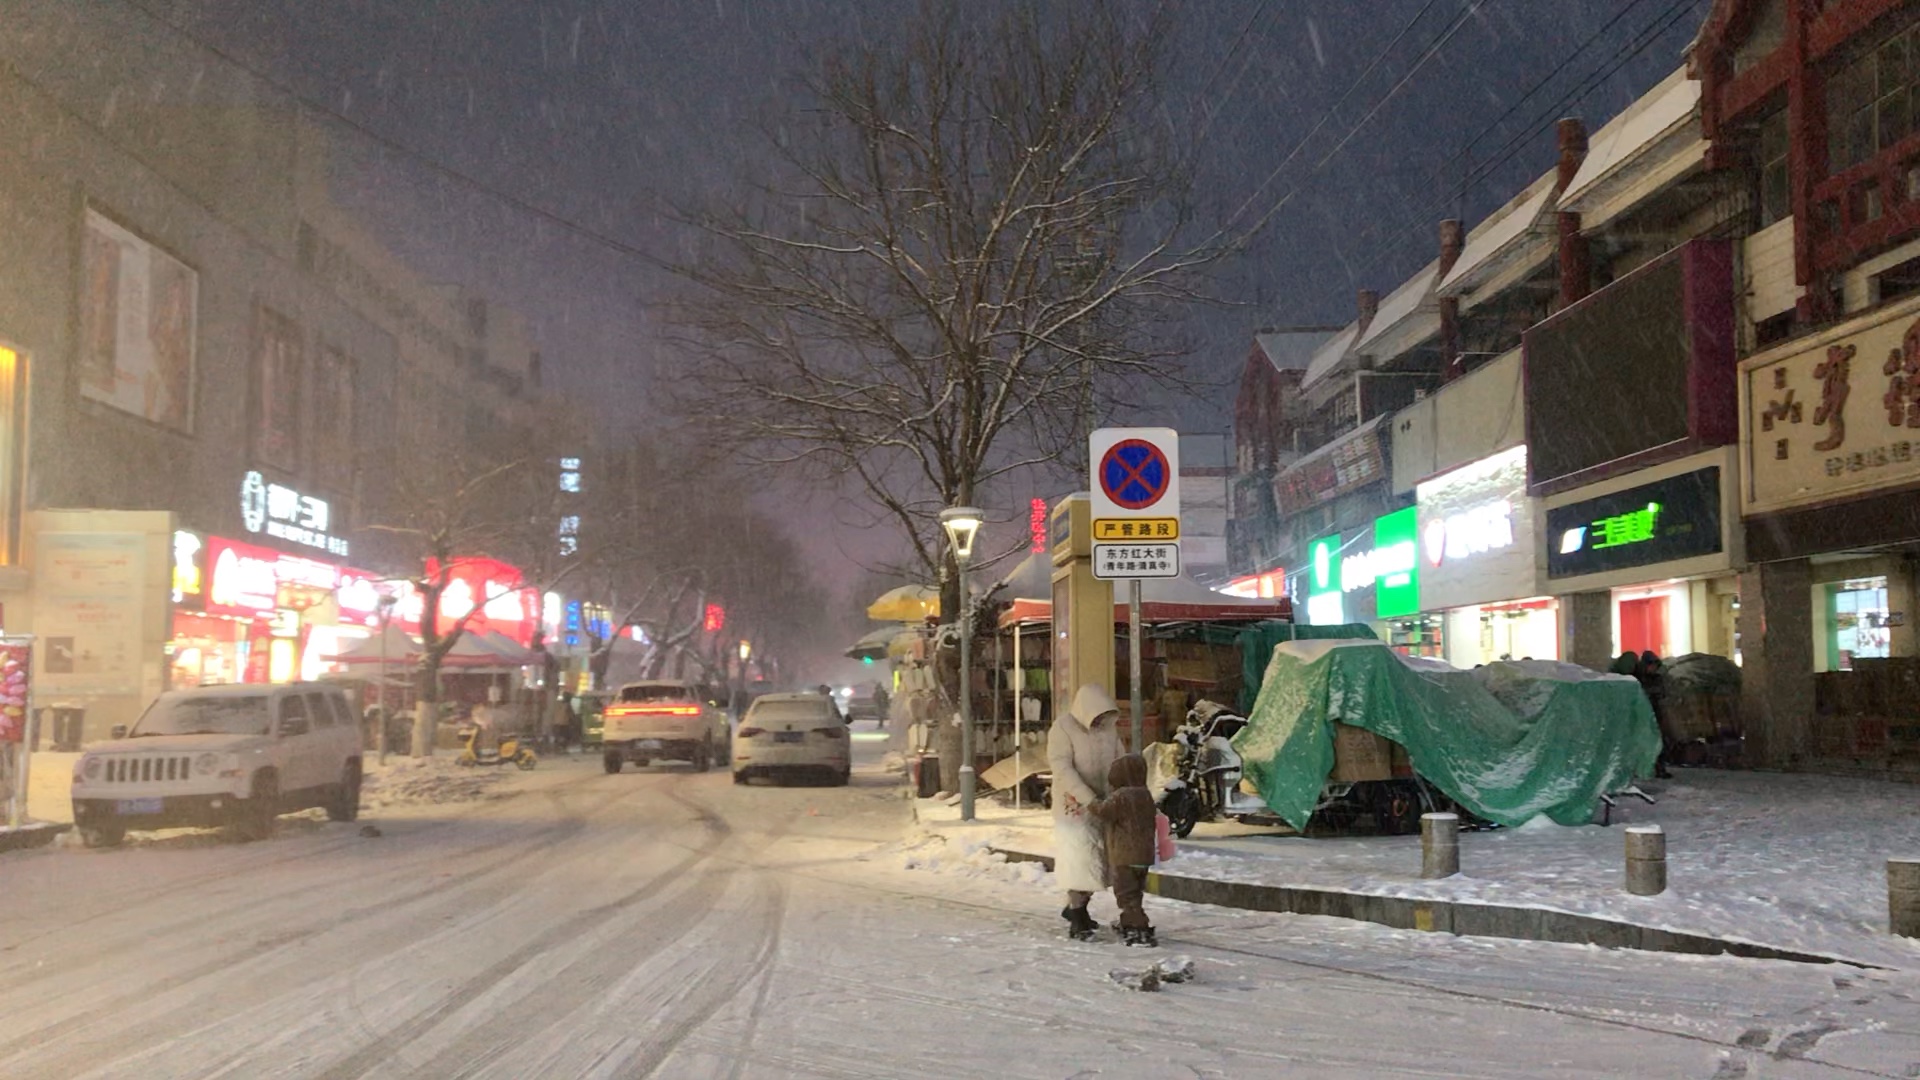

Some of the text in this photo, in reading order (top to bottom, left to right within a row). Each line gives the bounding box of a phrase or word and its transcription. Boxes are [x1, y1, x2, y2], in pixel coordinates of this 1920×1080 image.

[1103, 523, 1169, 536] 严管路段
[1106, 548, 1166, 560] 东方红大街
